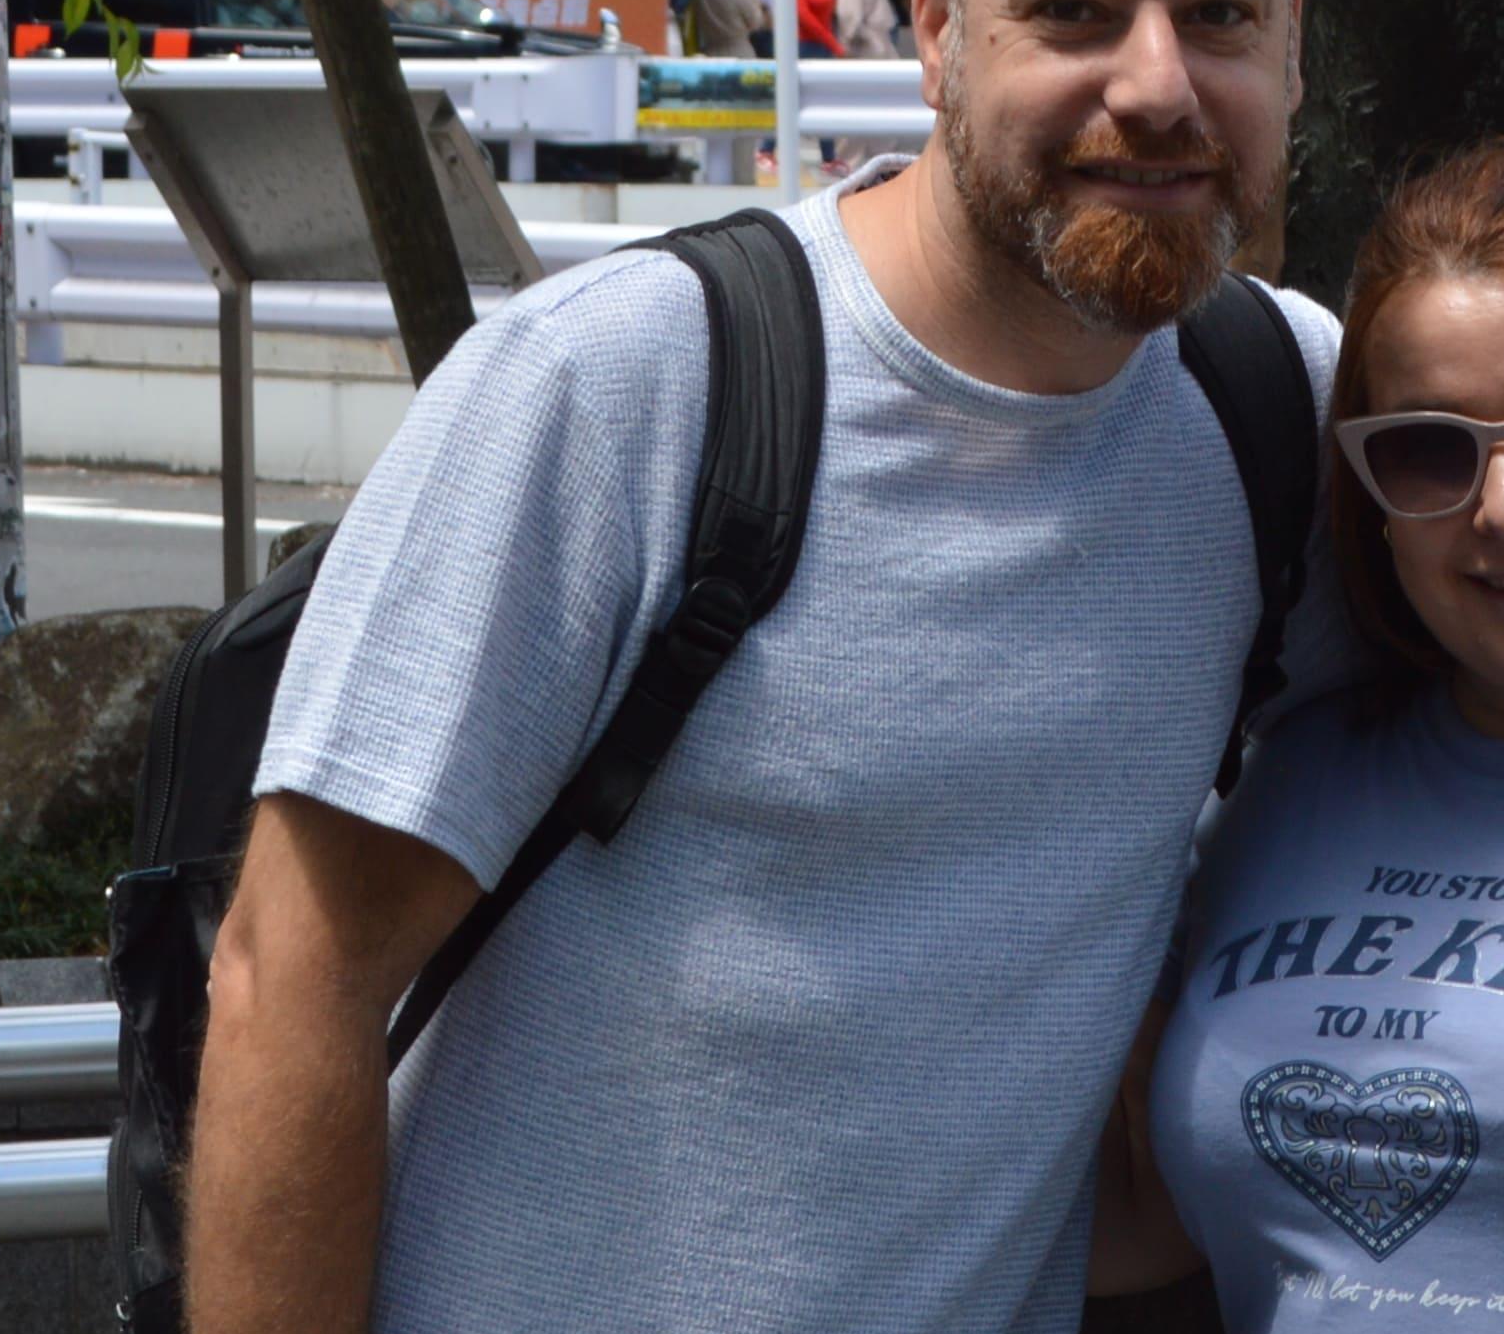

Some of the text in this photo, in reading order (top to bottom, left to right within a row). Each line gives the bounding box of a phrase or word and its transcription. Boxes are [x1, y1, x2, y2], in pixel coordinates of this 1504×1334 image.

[1363, 866, 1439, 898] YOU
[1207, 914, 1415, 1001] THE
[1313, 1003, 1441, 1041] TO MY
[1328, 1274, 1371, 1303] let
[1372, 1284, 1416, 1311] you
[1418, 1278, 1482, 1315] keep
